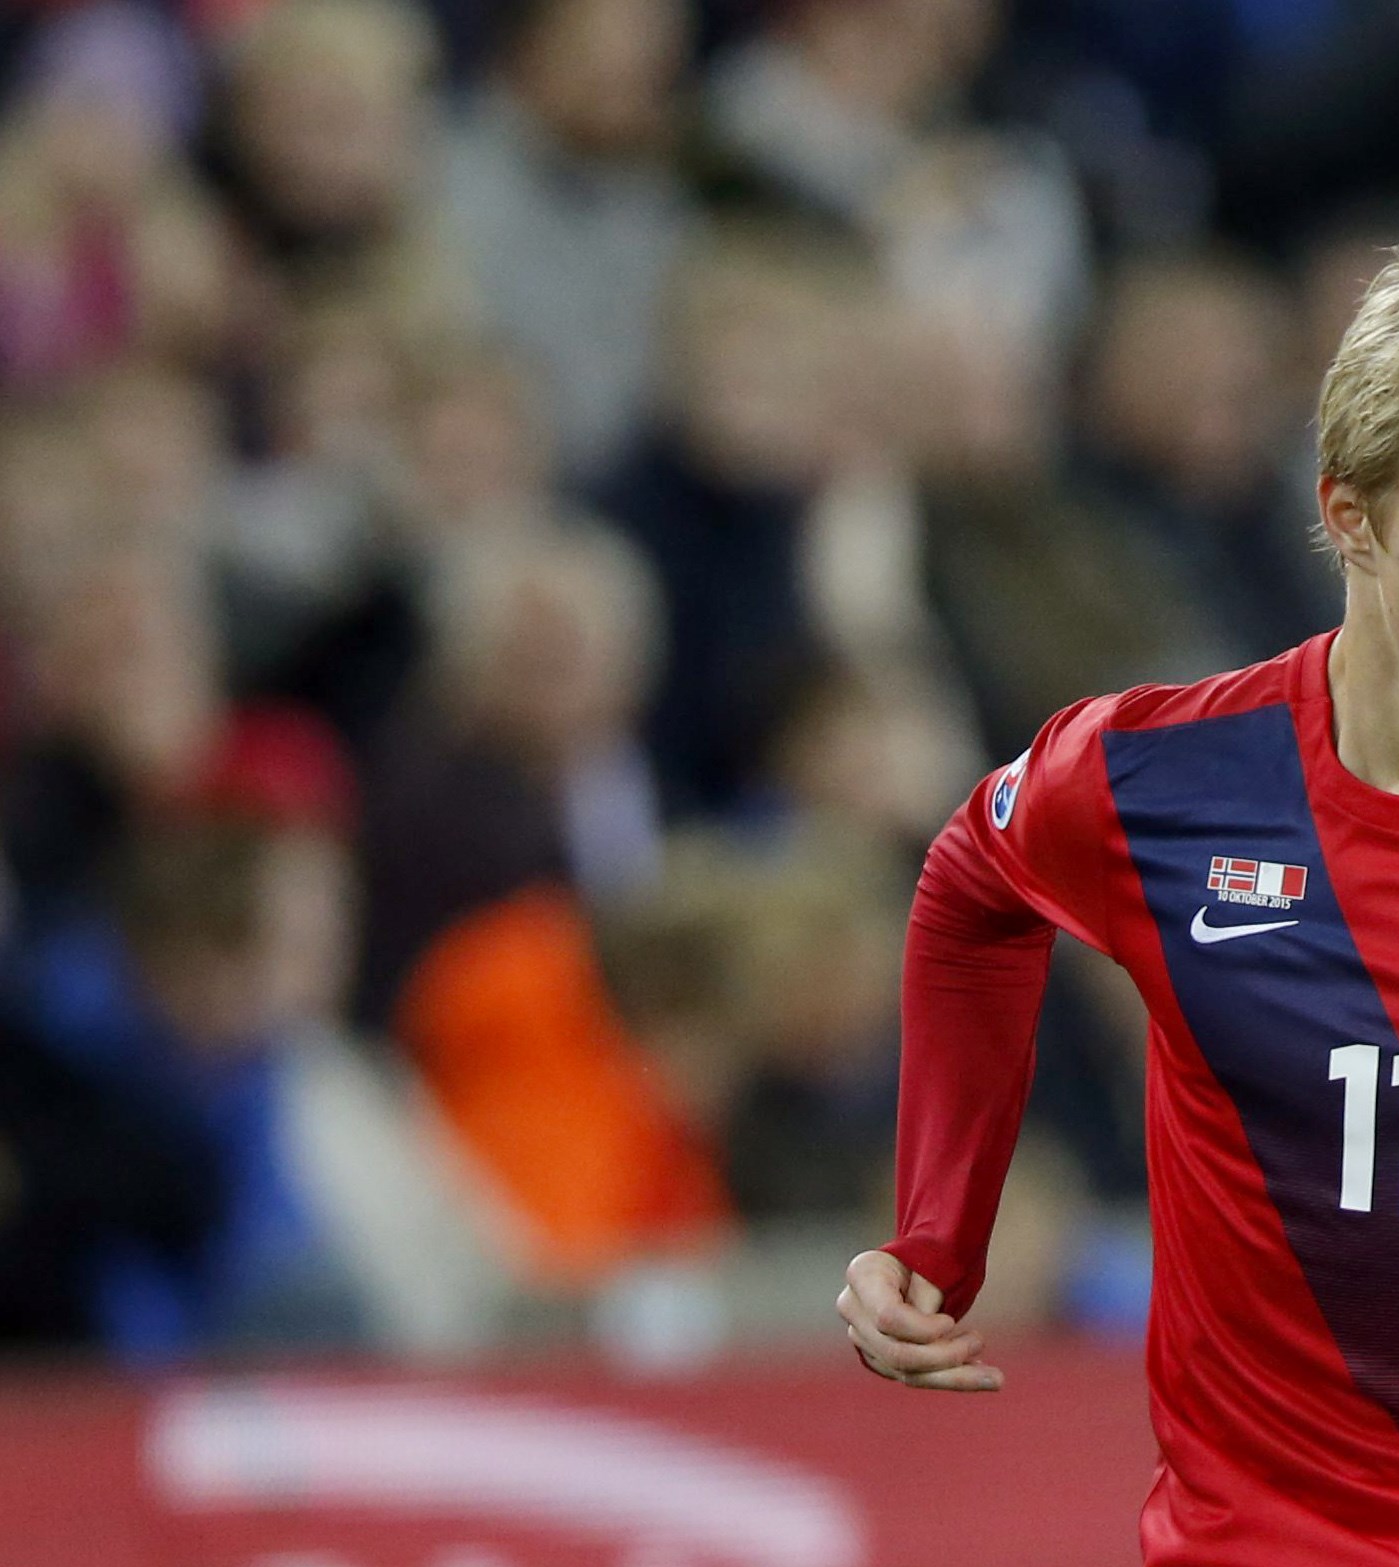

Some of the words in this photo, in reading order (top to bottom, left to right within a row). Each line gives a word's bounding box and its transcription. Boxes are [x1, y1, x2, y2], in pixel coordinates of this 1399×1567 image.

[1218, 891, 1229, 902] 10
[1230, 892, 1269, 907] OKTOBER
[1269, 898, 1292, 910] 2015
